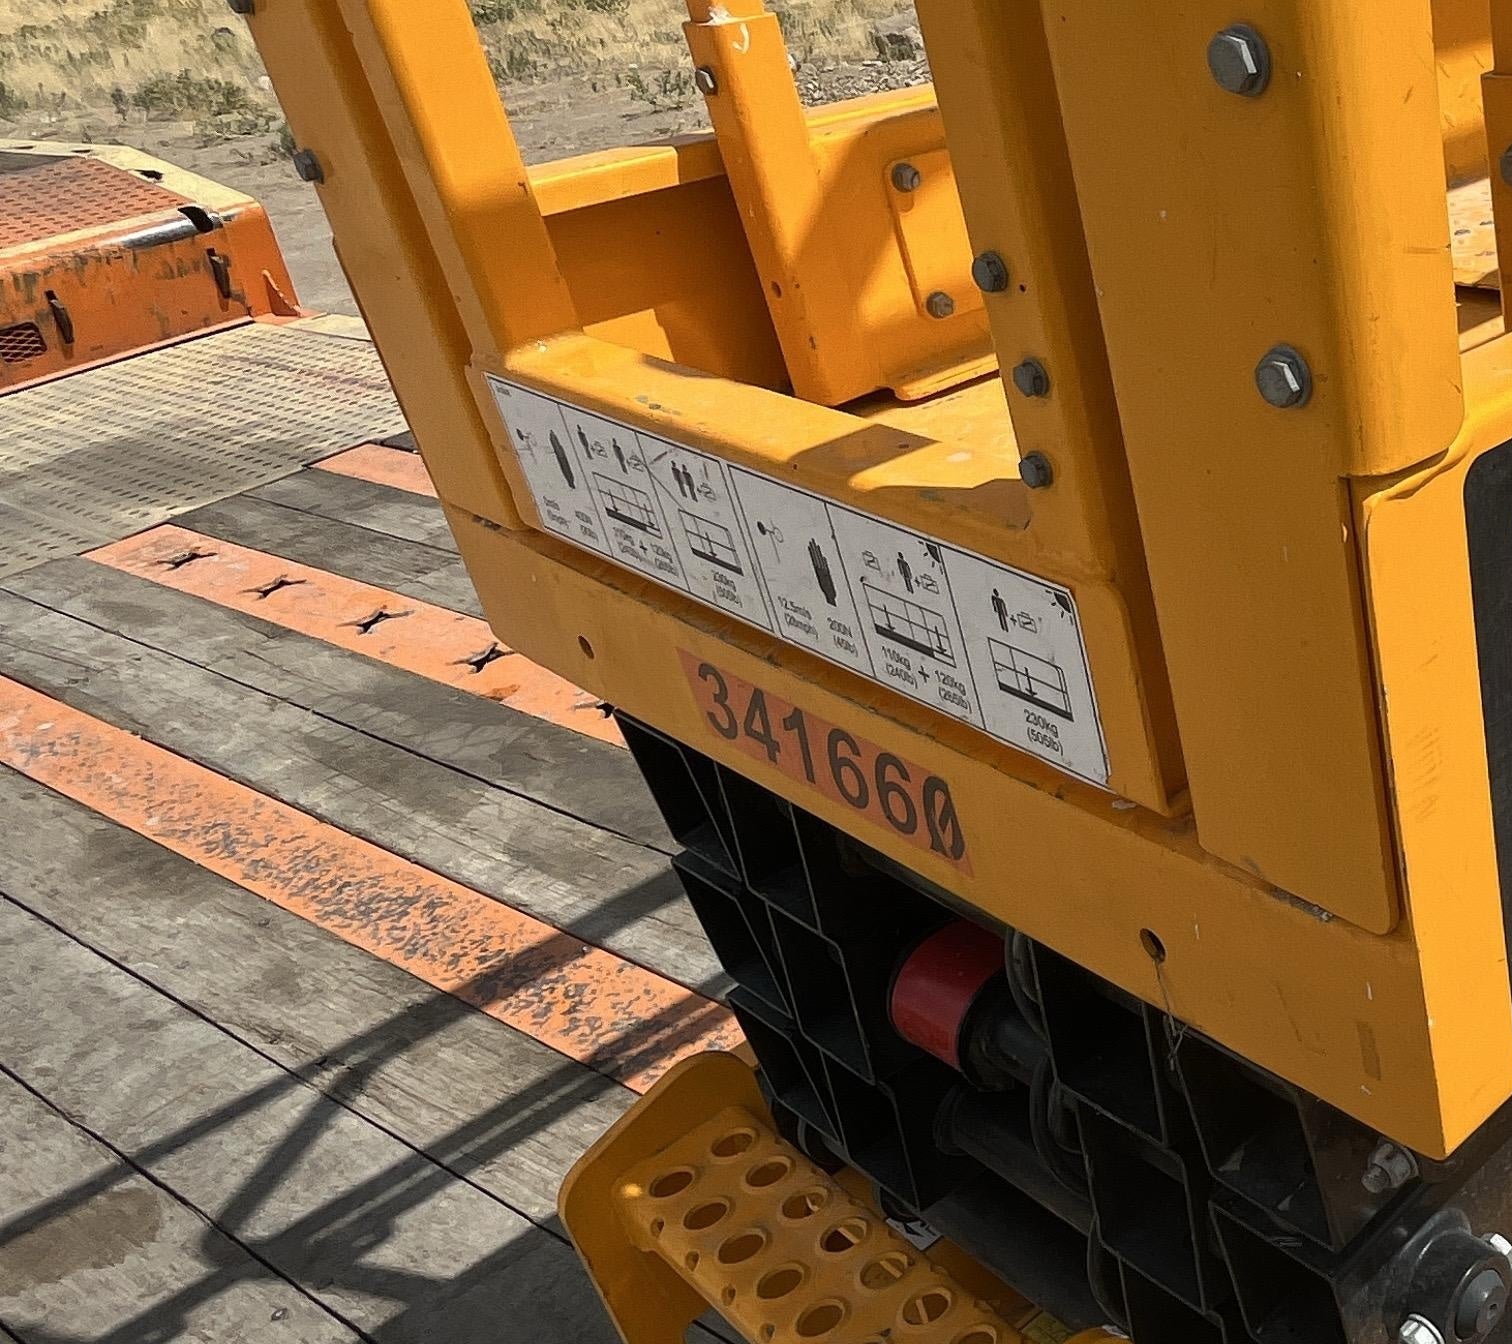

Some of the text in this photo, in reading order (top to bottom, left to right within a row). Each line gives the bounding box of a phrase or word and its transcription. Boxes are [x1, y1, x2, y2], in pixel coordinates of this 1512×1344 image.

[1023, 708, 1060, 739] 230kg
[1026, 728, 1065, 757] (505lb)
[697, 662, 966, 862] 341660
